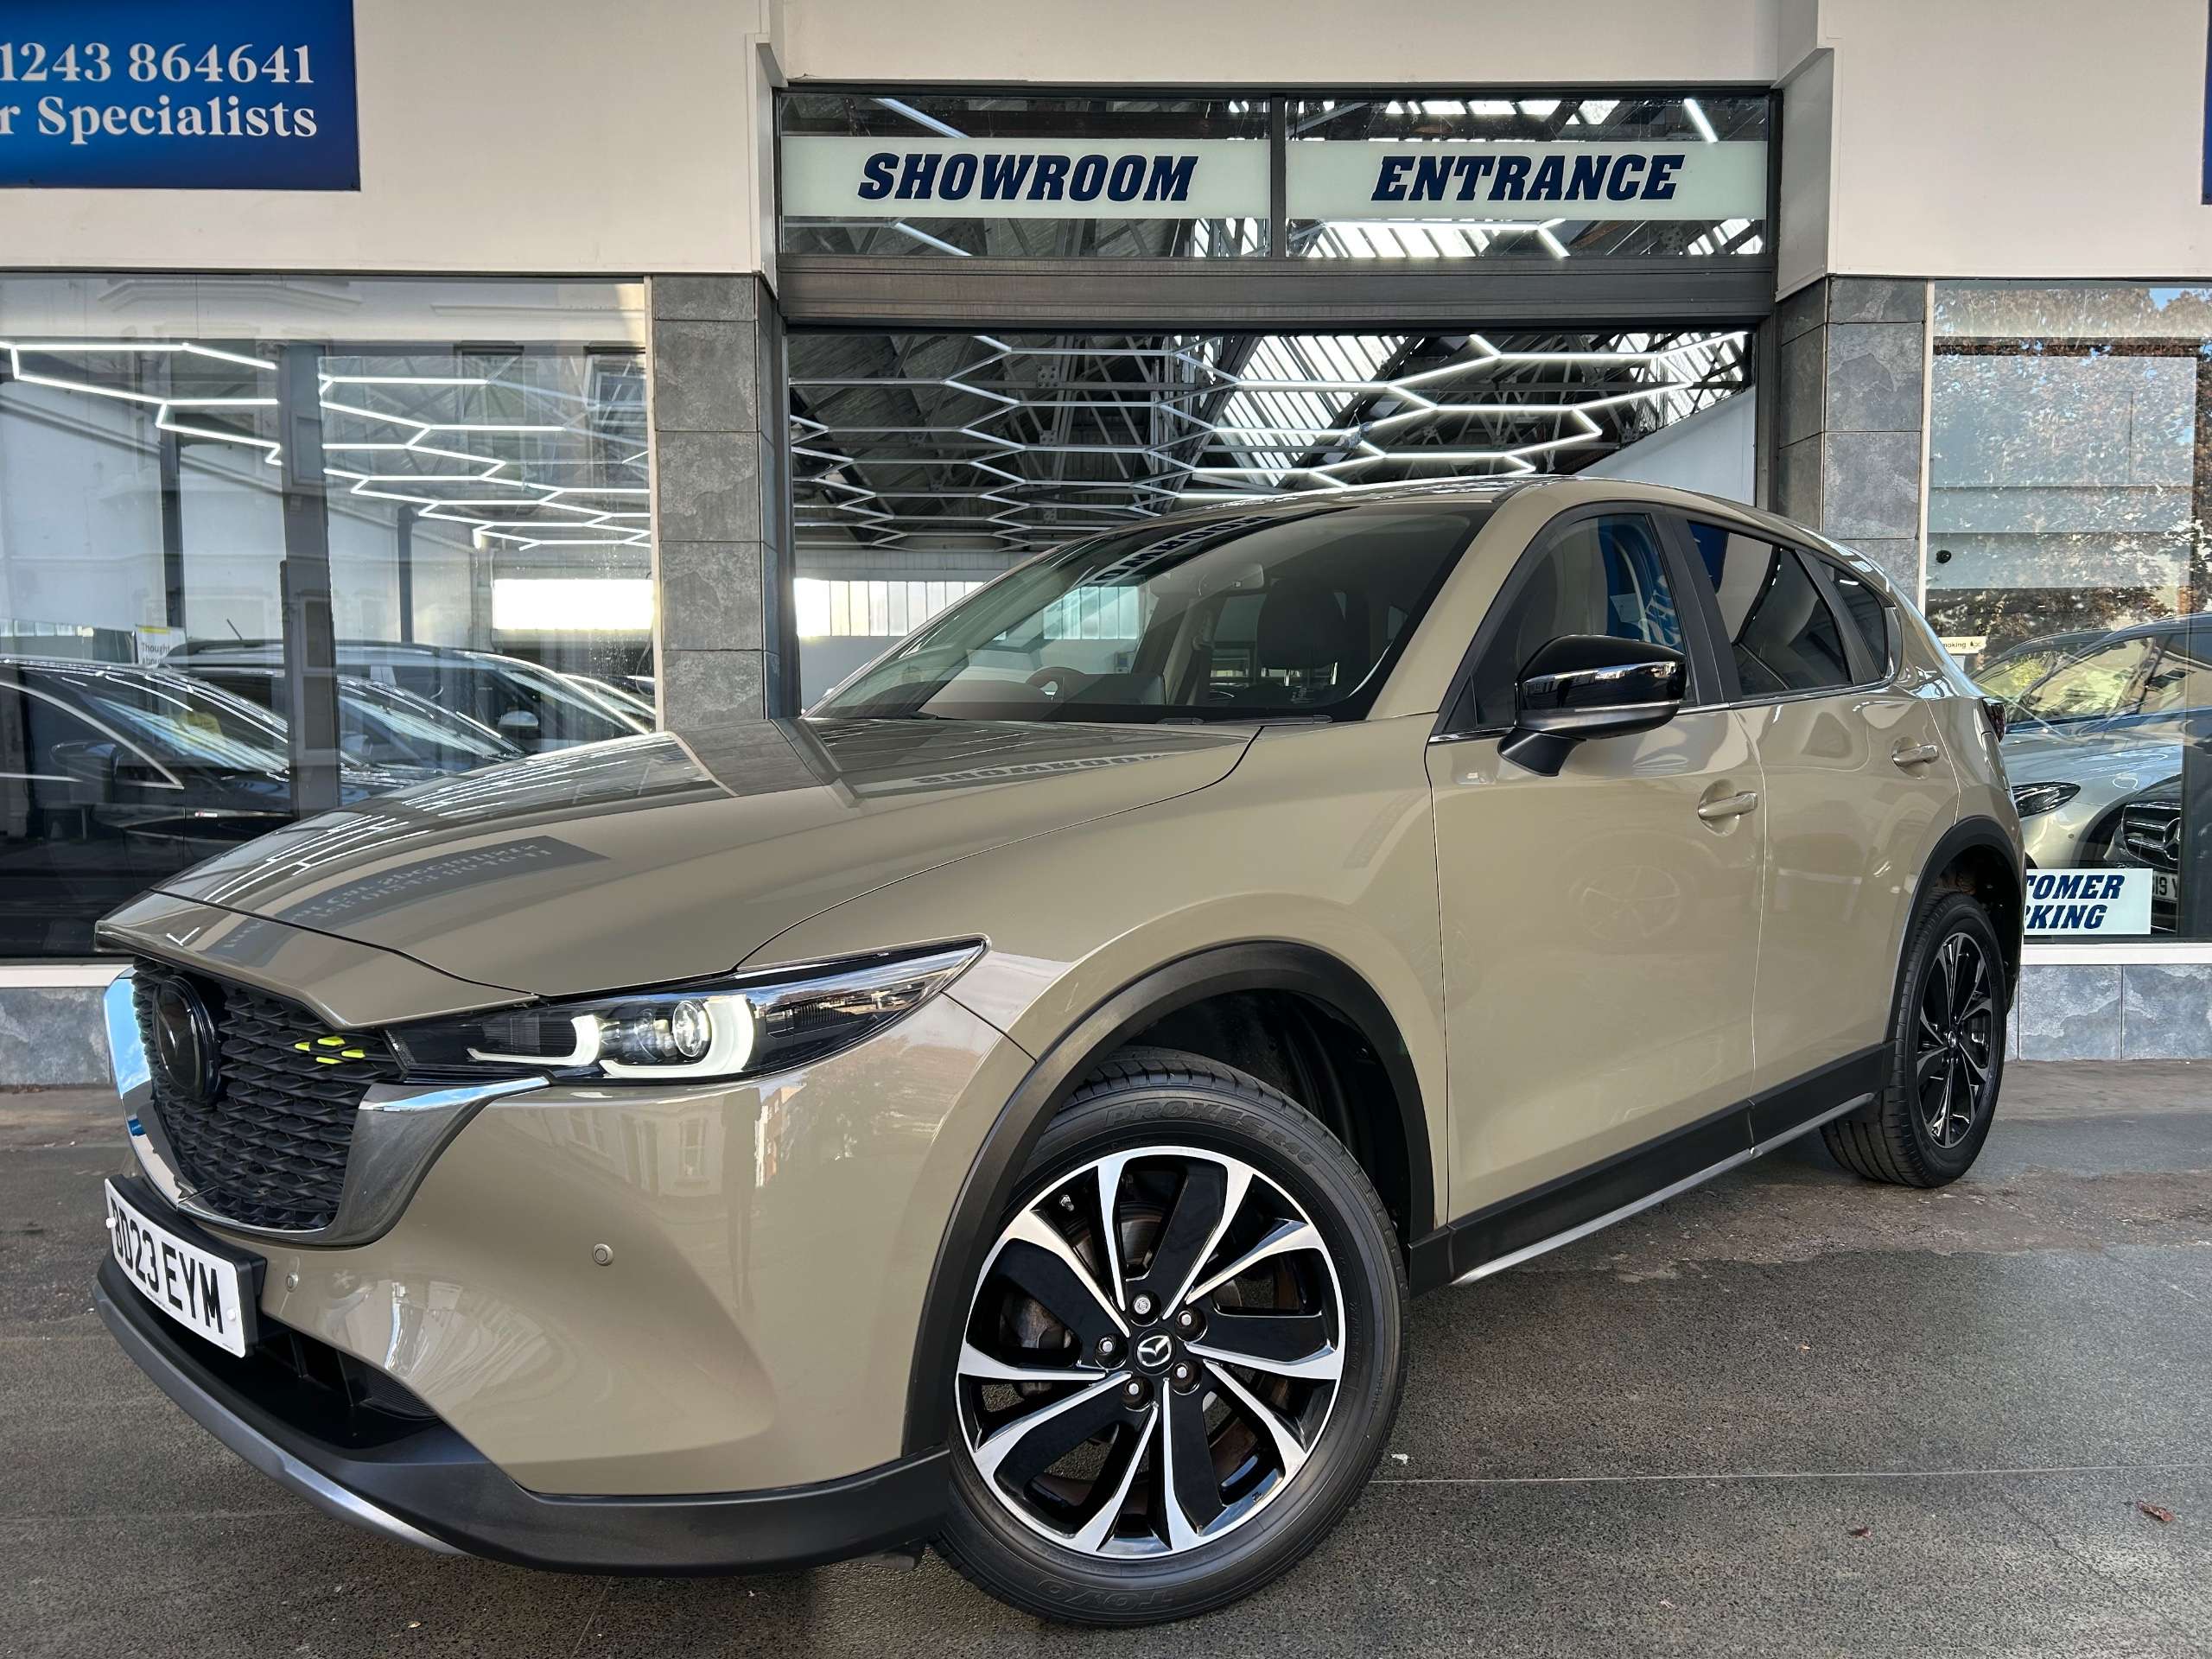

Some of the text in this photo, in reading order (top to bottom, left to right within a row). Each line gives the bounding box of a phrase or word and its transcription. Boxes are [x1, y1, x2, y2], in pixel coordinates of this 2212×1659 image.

[0, 42, 315, 84] 1243 864641
[37, 95, 318, 145] Specialists
[857, 152, 1199, 201] SHOWROOM
[1370, 154, 1686, 201] ENTRANCE
[2025, 905, 2107, 929] KING
[162, 1240, 224, 1335] EYM
